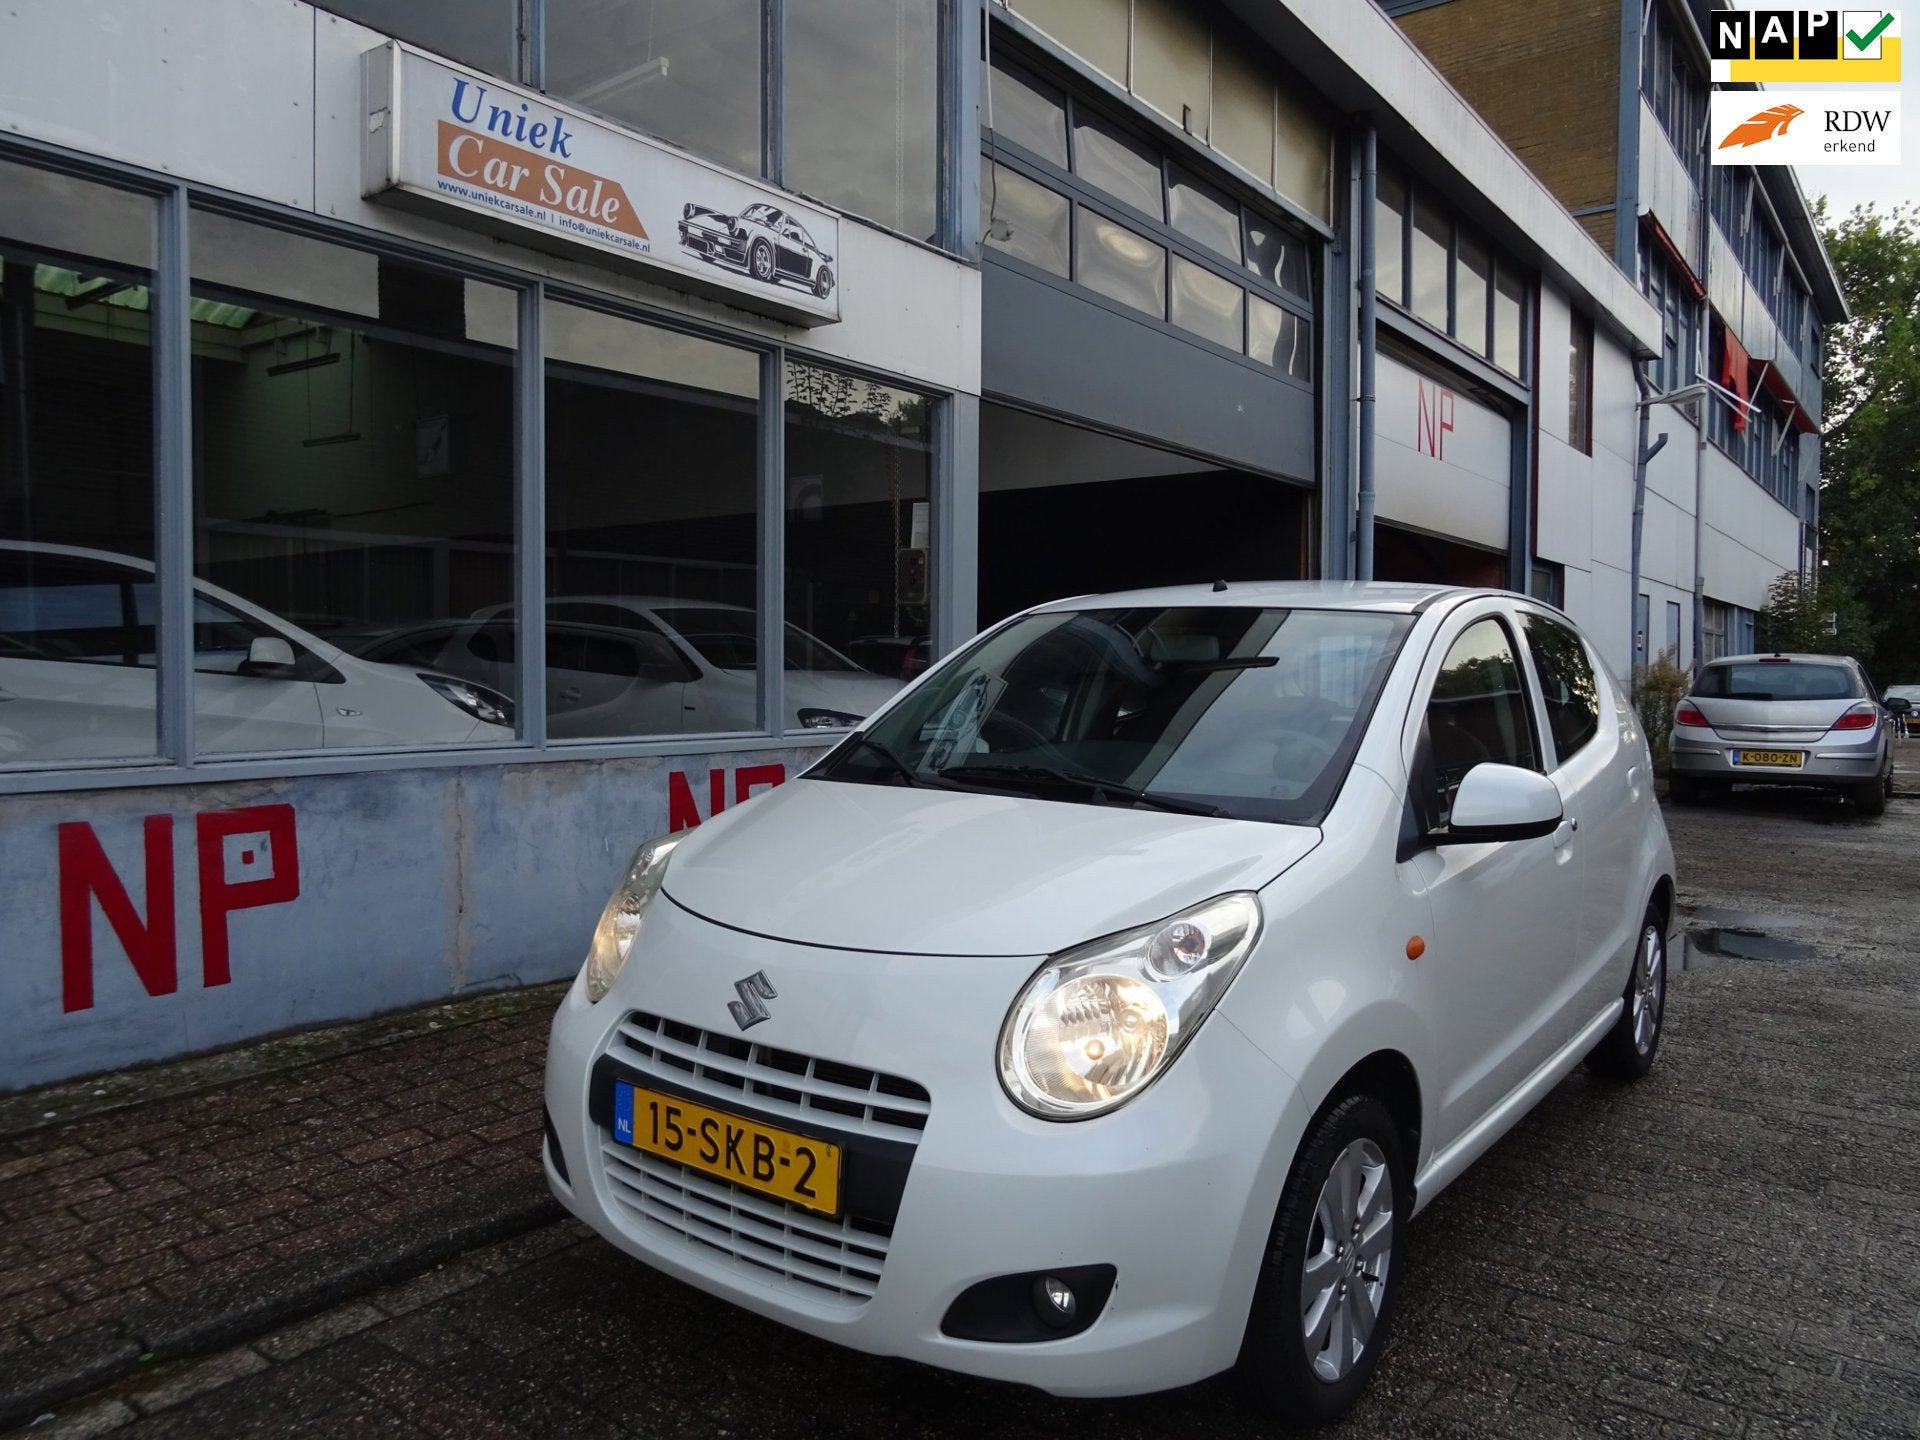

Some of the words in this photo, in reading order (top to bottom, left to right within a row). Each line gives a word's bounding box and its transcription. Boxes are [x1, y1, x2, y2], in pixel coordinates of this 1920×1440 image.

[451, 77, 573, 159] Uniek
[437, 179, 546, 221] www.uniekcarsale.nl
[559, 216, 650, 253] info@uniekcarsale.nl
[448, 133, 530, 192] Car
[539, 165, 620, 224] Sale
[1418, 375, 1454, 461] NP
[1742, 752, 1798, 763] K-080-ZN
[57, 803, 300, 1014] NP
[617, 1117, 632, 1134] NL
[649, 1101, 817, 1198] 15-SKB-2
